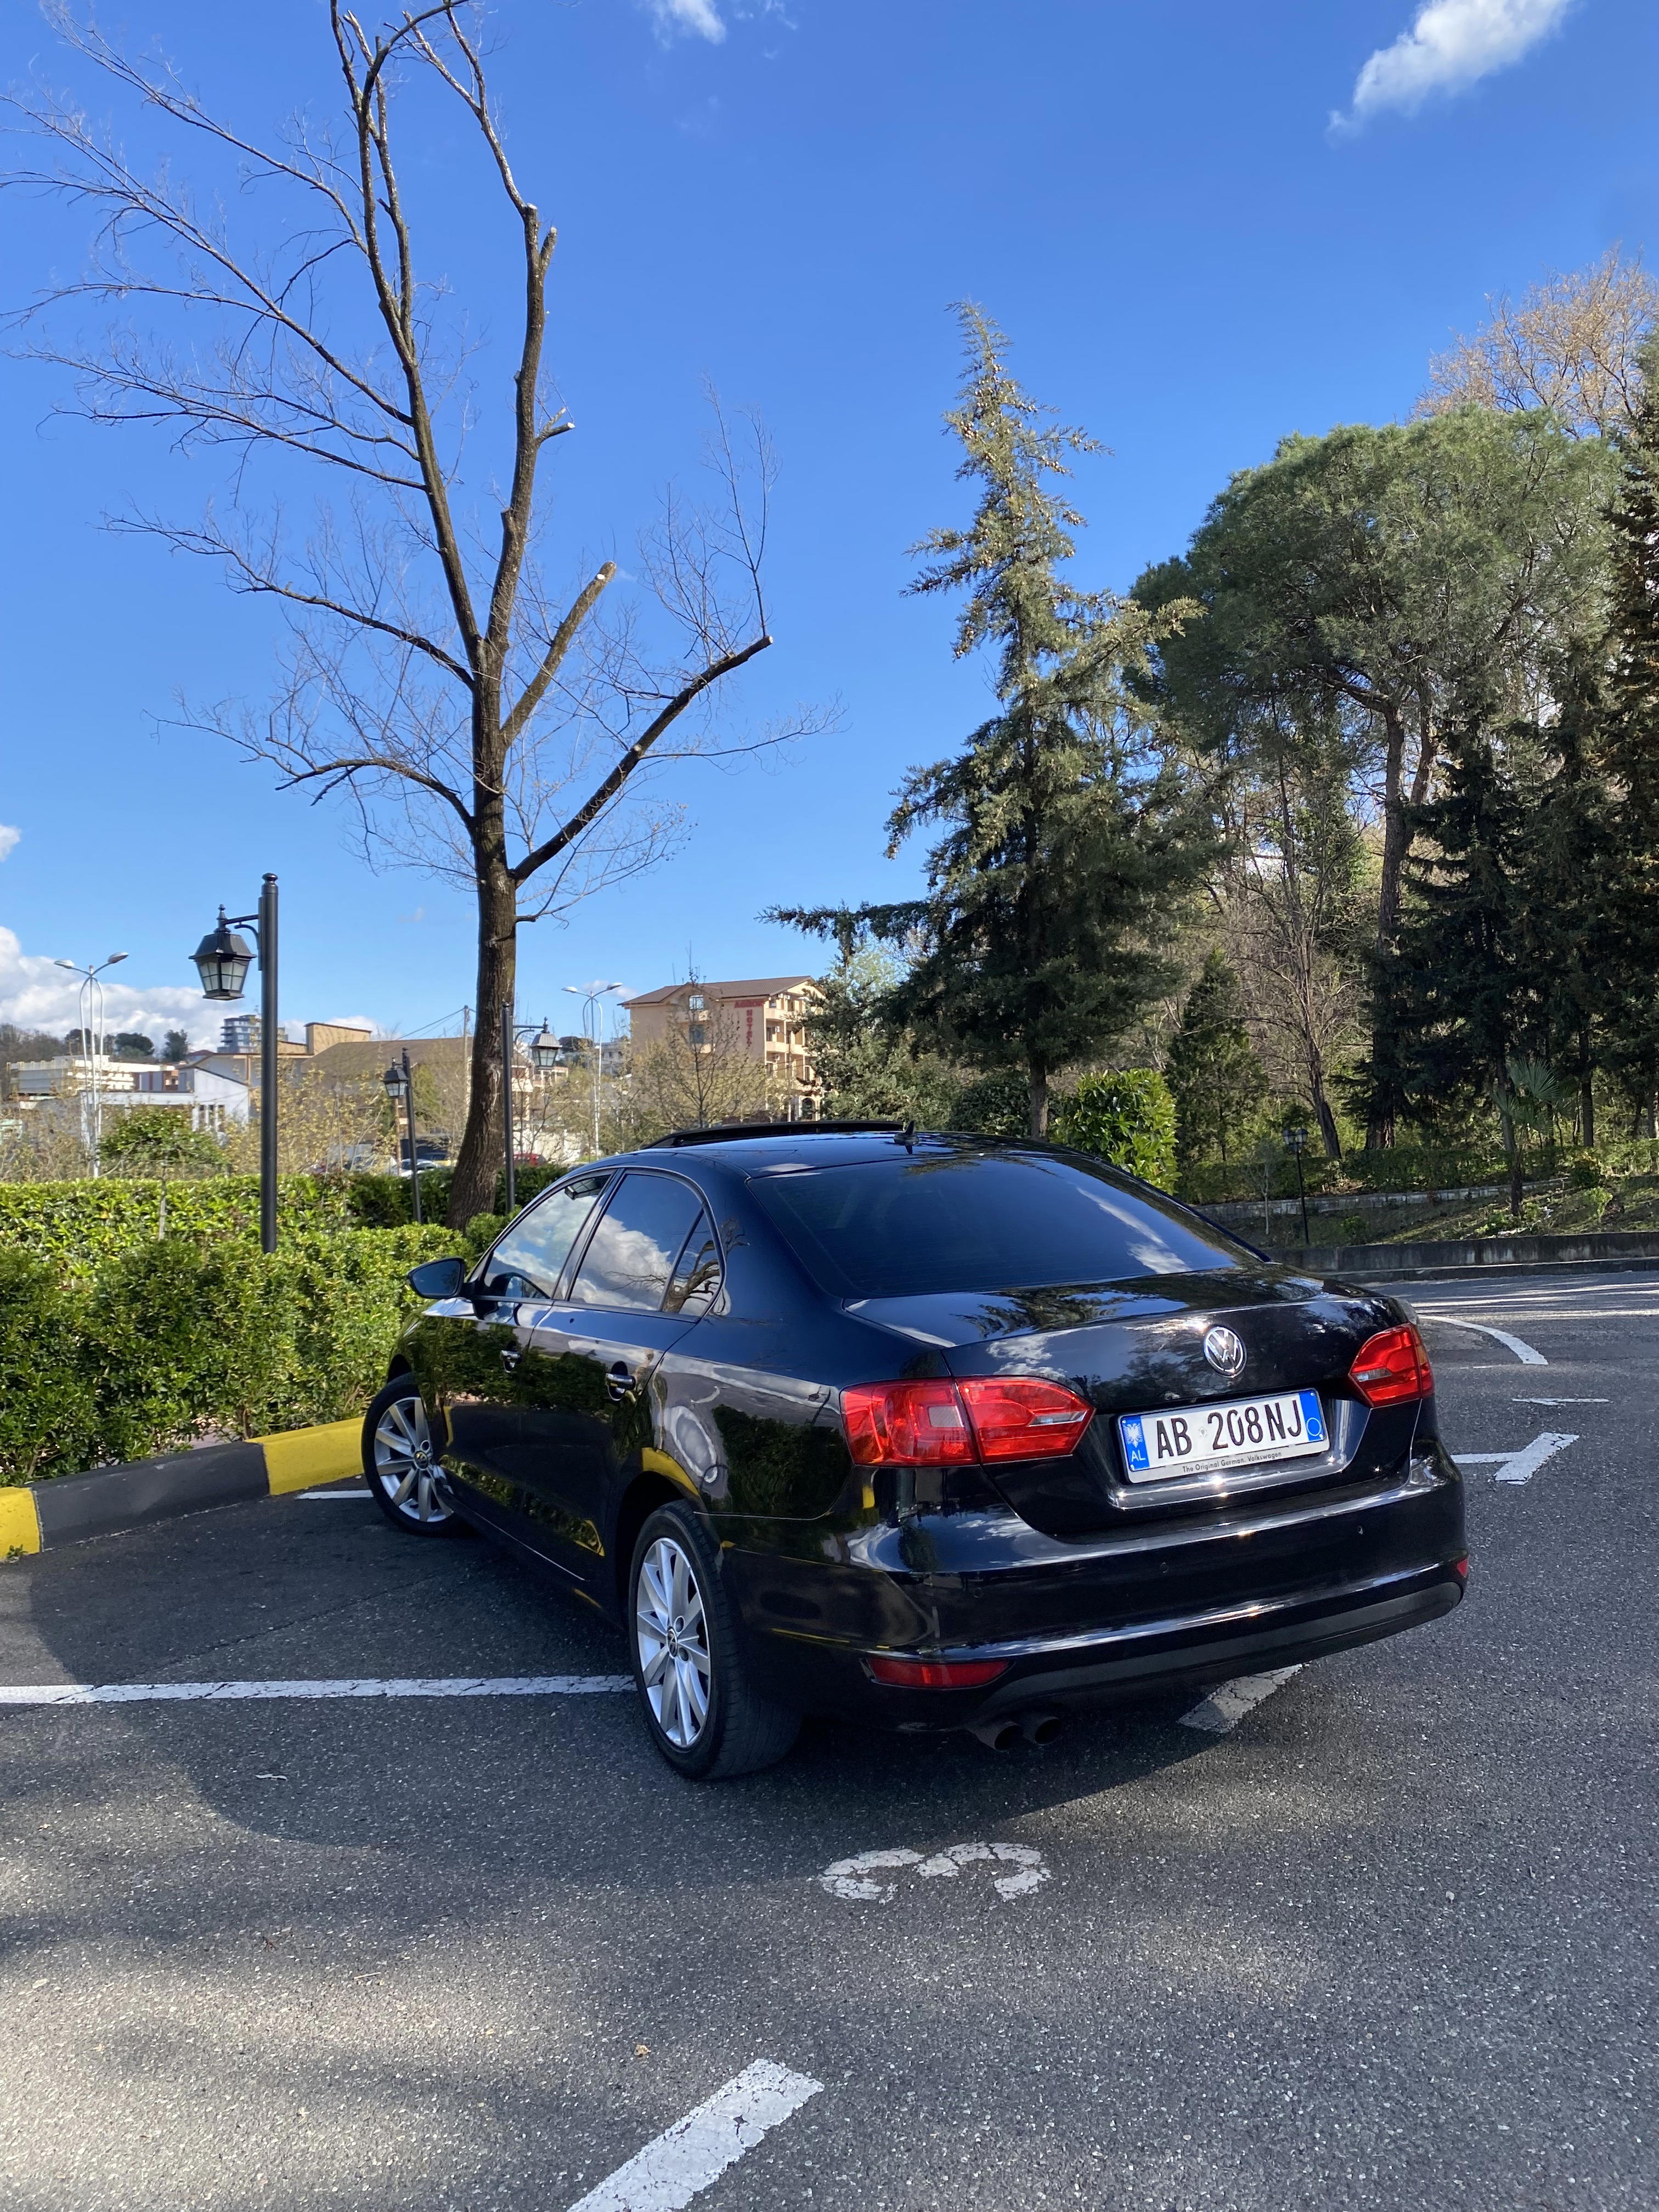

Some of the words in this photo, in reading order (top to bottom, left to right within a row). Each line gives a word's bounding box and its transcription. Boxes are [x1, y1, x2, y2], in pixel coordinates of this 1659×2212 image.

[1156, 1418, 1192, 1459] AB
[1131, 1449, 1146, 1462] AL
[1195, 1460, 1220, 1470] Original
[1247, 1452, 1282, 1462] Volkswagen
